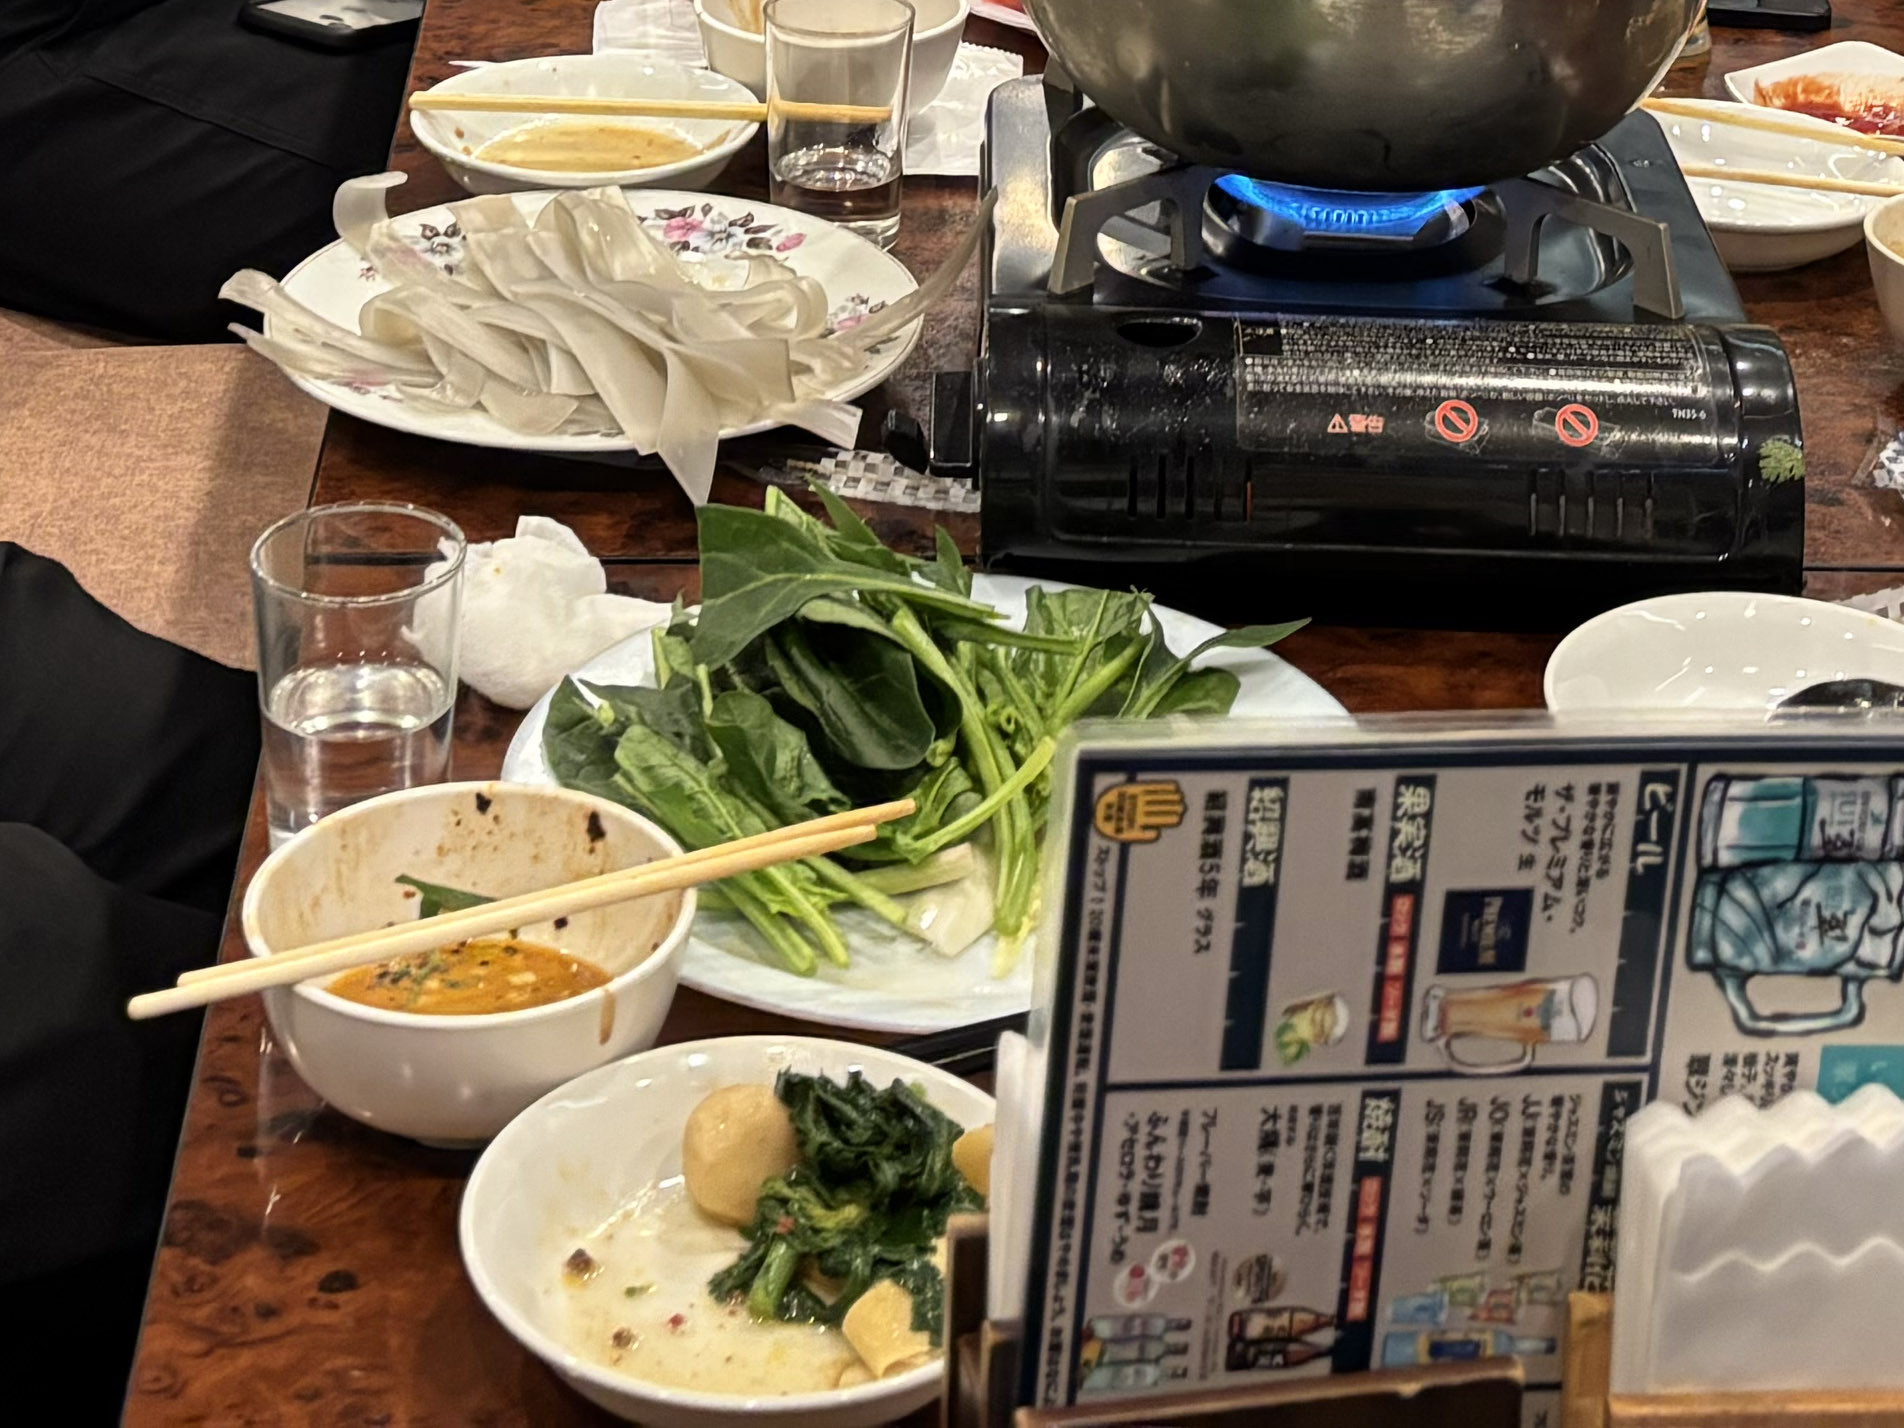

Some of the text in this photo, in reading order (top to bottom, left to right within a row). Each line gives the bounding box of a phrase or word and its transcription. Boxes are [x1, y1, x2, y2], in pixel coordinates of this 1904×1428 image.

[1388, 784, 1431, 884] 果実酒
[1516, 853, 1538, 873] 生
[1635, 782, 1673, 875] ビール
[1193, 907, 1214, 955] グラス
